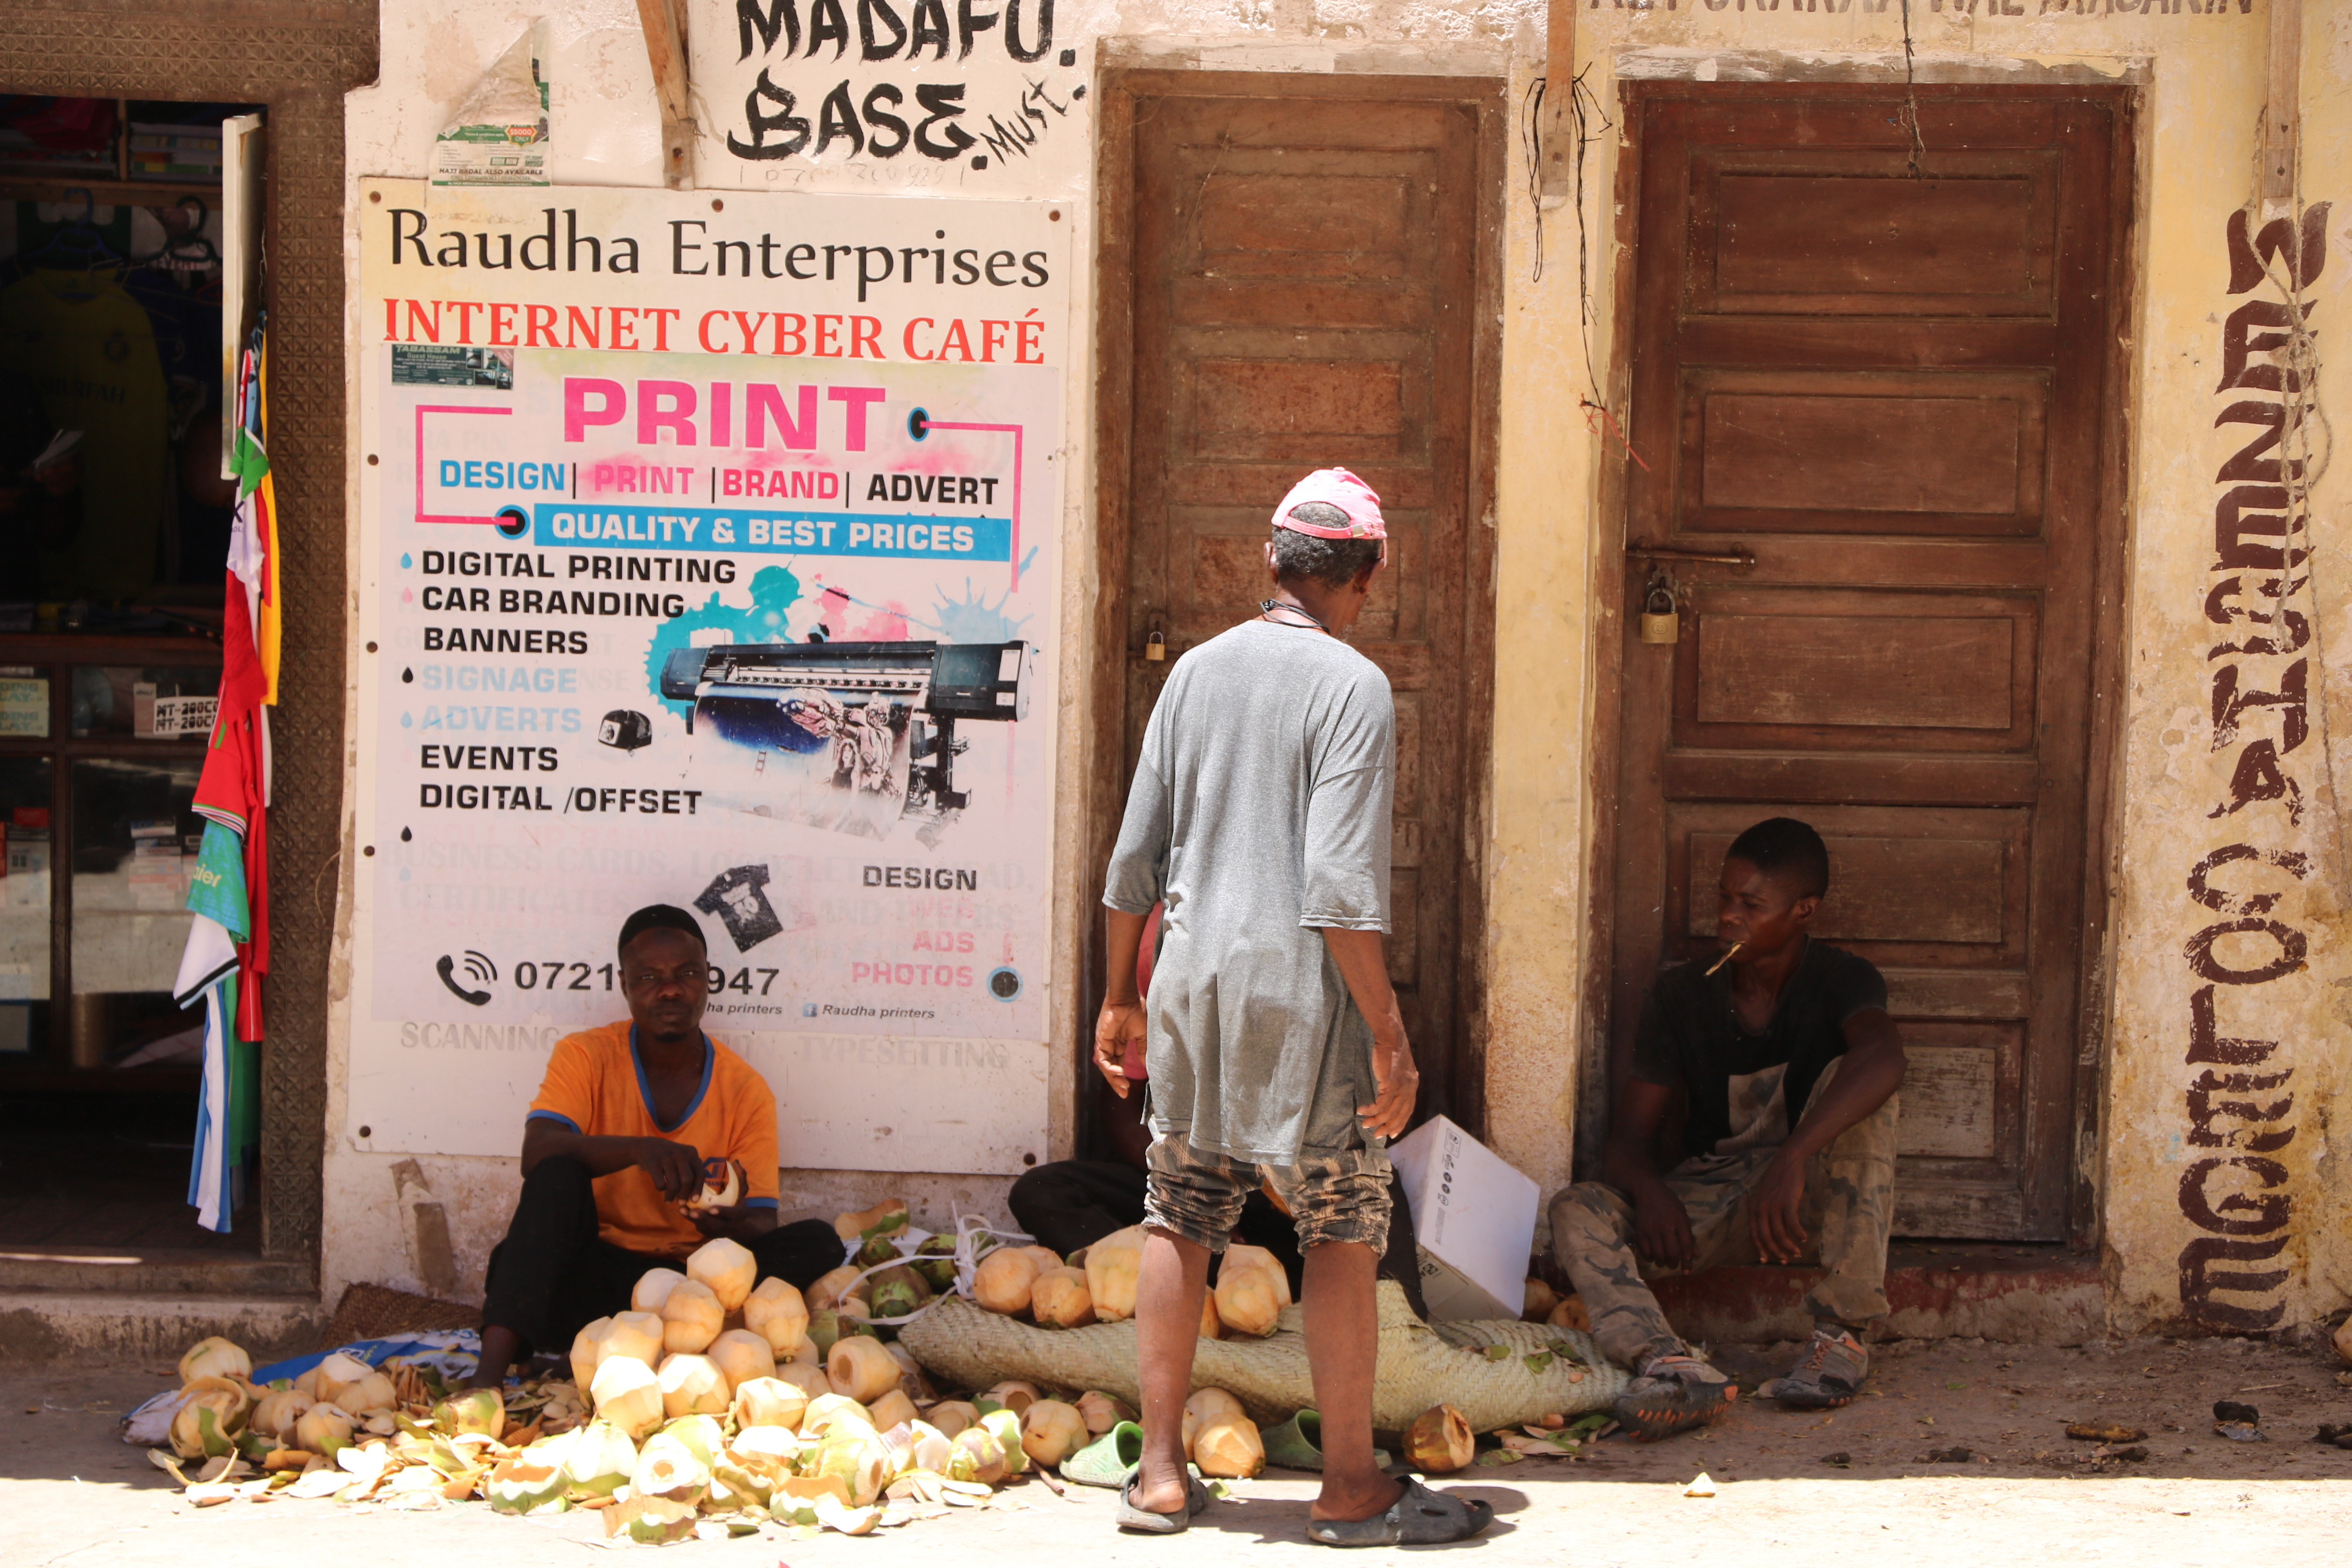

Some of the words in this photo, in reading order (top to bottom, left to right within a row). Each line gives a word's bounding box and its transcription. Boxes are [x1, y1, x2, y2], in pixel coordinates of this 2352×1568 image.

[736, 0, 1076, 66] MADAFU.
[726, 66, 987, 170] BASE.
[387, 207, 639, 273] Raudha
[667, 219, 1049, 302] Enterprises
[383, 298, 681, 353] INTERNET
[697, 309, 886, 359] CYBER
[903, 307, 1045, 364] CAFÉ
[395, 344, 461, 354] TABASSAM
[563, 377, 886, 452] PRINT
[440, 460, 565, 491] DESIGN
[594, 464, 694, 495] PRINT
[723, 469, 839, 500] BRAND
[866, 473, 998, 505] ADVERT
[552, 512, 701, 542] QUALITY
[711, 517, 736, 544] &
[748, 519, 837, 548] BEST
[849, 522, 974, 552] PRICES
[422, 550, 555, 577] DIGITAL
[569, 554, 736, 584] PRINTING
[422, 586, 490, 613] CAR
[499, 589, 684, 618] BRANDING
[424, 627, 588, 655] BANNERS
[422, 665, 577, 694] SIGNAGE
[421, 705, 581, 733] ADVERTS
[421, 744, 558, 772] EVENTS
[419, 783, 552, 811] DIGITAL
[564, 786, 703, 815] /OFFSET
[862, 865, 977, 891] DESIGN
[913, 931, 975, 954] ADS
[514, 962, 613, 991] 0721
[851, 962, 974, 987] PHOTOS
[728, 1003, 782, 1017] printers
[822, 1004, 876, 1018] Raudha
[879, 1006, 935, 1020] printers
